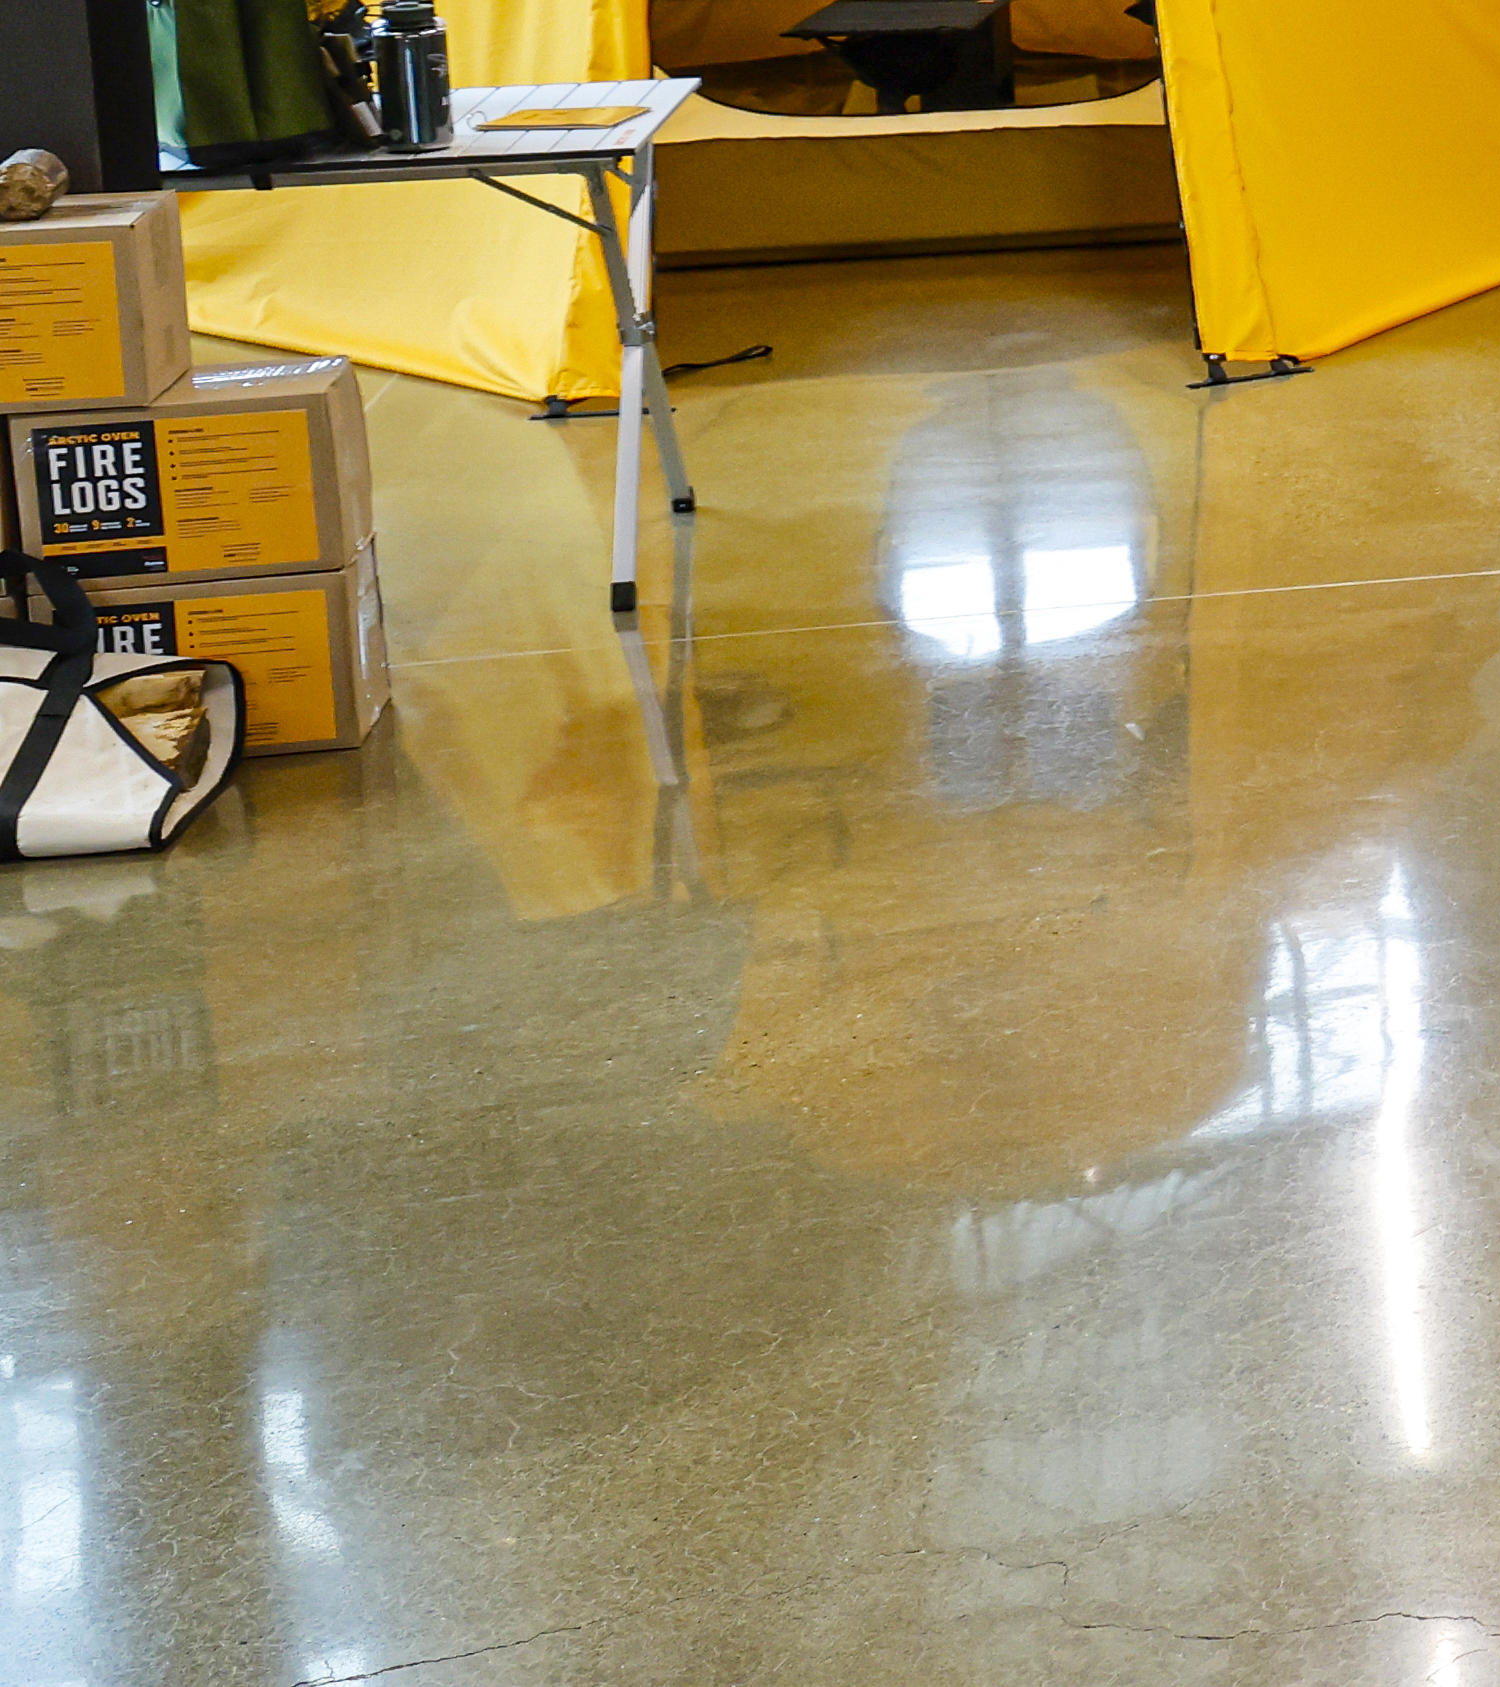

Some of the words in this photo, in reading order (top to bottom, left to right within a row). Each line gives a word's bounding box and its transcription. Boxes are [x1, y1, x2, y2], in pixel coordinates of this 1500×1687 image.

[48, 432, 98, 446] ARCTIC
[100, 431, 141, 443] OVEN
[47, 442, 145, 481] FIRE
[51, 477, 148, 516] LOGS
[53, 522, 69, 534] 30
[126, 517, 135, 528] 2
[97, 614, 118, 625] TIC
[122, 612, 160, 624] OVEN
[98, 623, 164, 655] IRE
